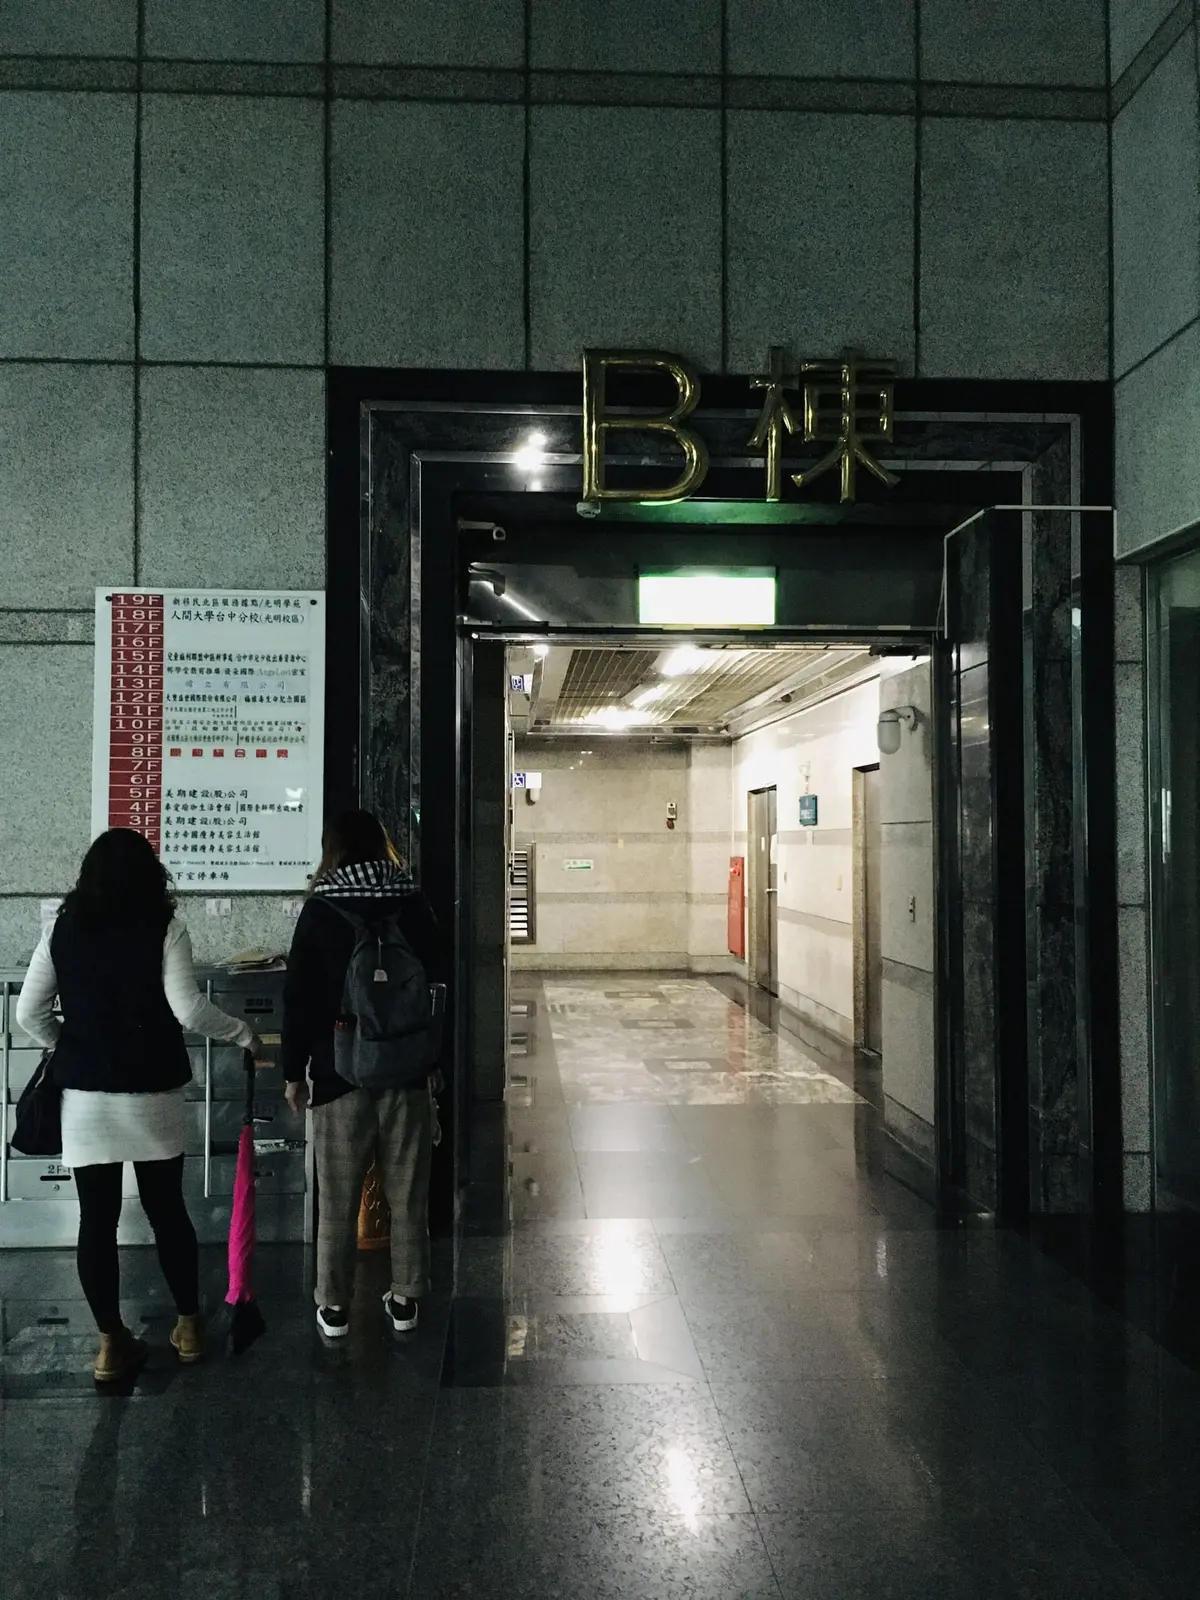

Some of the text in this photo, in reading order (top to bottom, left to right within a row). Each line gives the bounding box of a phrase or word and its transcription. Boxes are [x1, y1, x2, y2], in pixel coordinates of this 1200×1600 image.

[582, 346, 901, 505] B棟
[116, 595, 161, 606] 19F
[116, 609, 305, 623] 18F 人間大學台中分校(光明校區)
[116, 623, 161, 633] 17F
[116, 637, 161, 647] 16F
[116, 650, 161, 661] 15F
[116, 664, 161, 675] 14F
[116, 678, 161, 688] 13F
[115, 692, 161, 703] 12F
[115, 705, 160, 716] 11F
[115, 719, 160, 730] 10F
[131, 733, 160, 743] 9F
[131, 746, 159, 757] 8F
[131, 760, 159, 771] 7F
[130, 774, 159, 785] 6F
[129, 787, 158, 799] 5F
[129, 801, 157, 812] 4F
[129, 815, 157, 826] 3F
